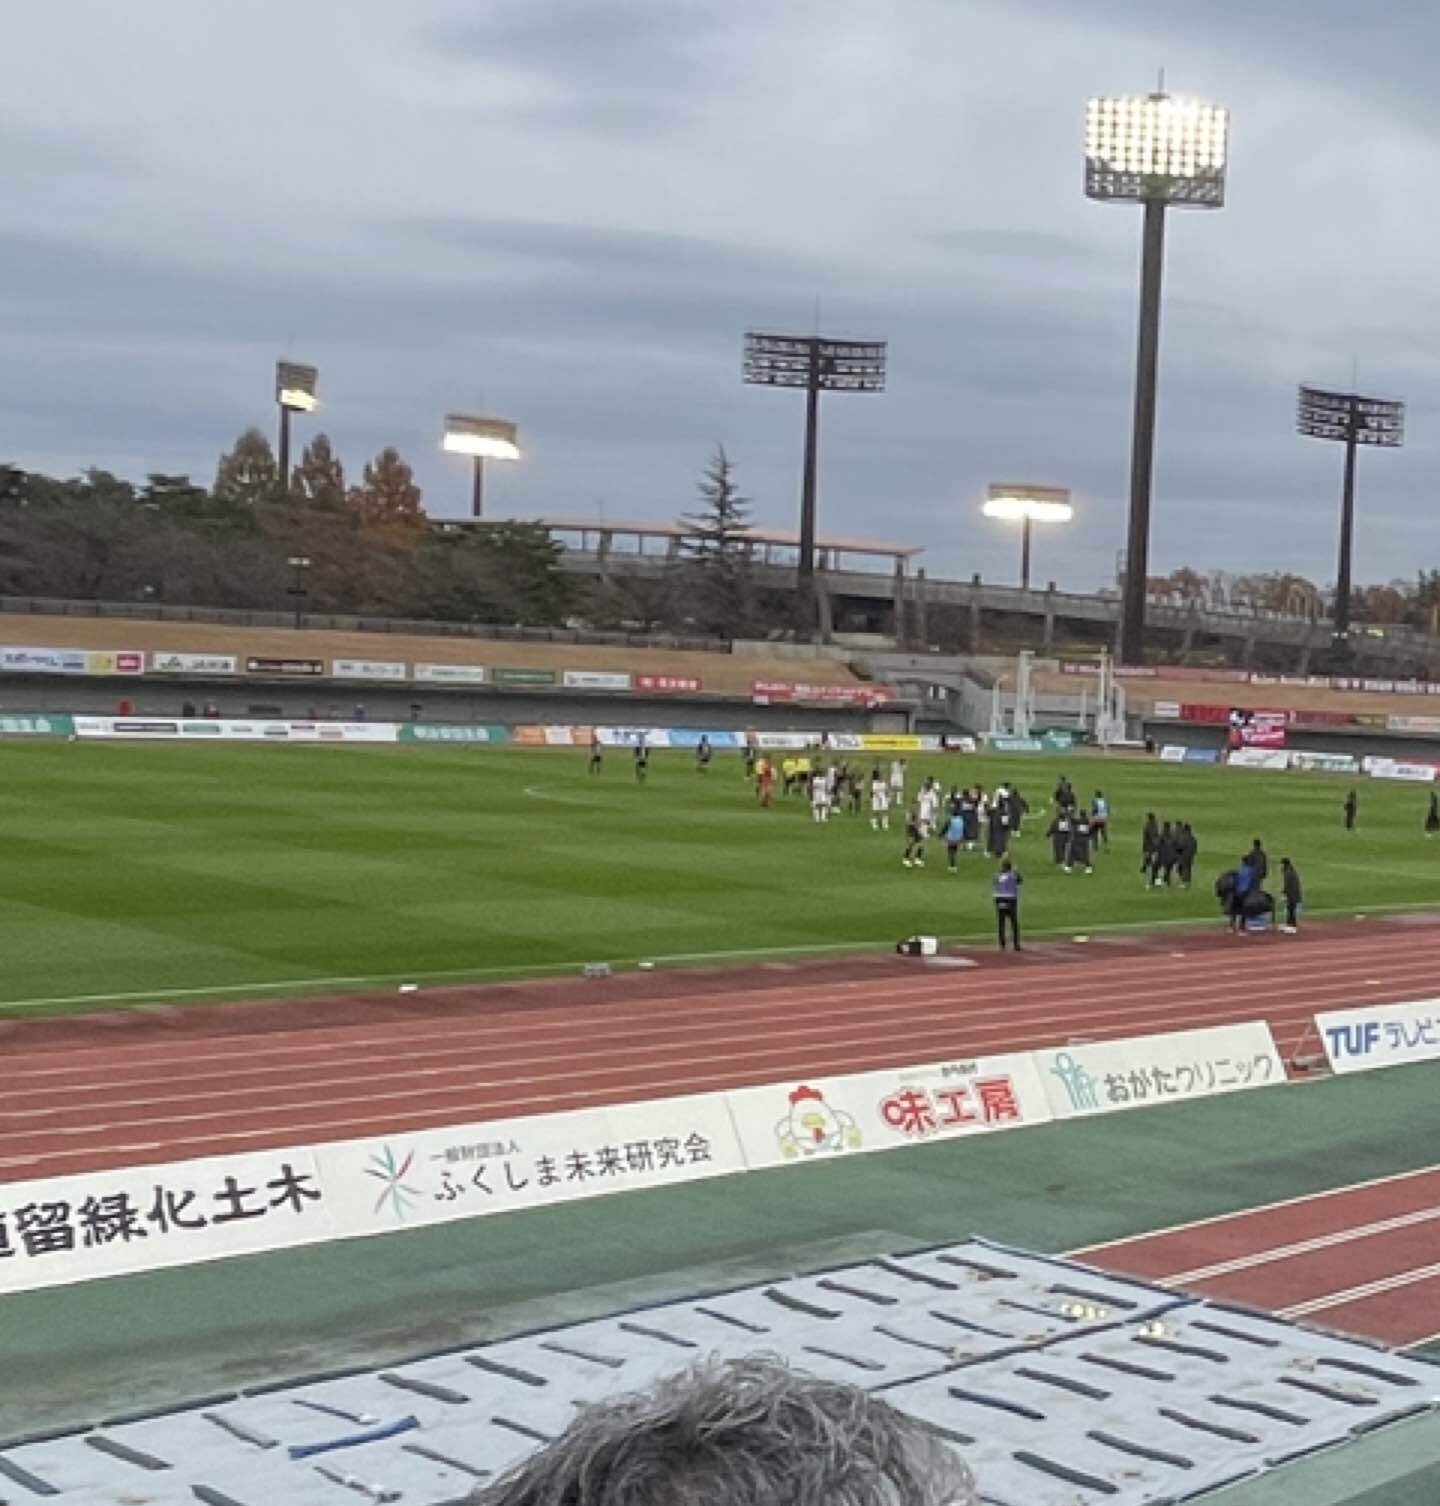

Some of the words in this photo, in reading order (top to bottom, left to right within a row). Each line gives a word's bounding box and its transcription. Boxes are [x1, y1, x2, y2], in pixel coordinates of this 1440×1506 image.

[1326, 1022, 1378, 1058] TUF
[881, 1079, 1019, 1133] 味工房
[435, 1130, 712, 1200] ふくしま未来研究会
